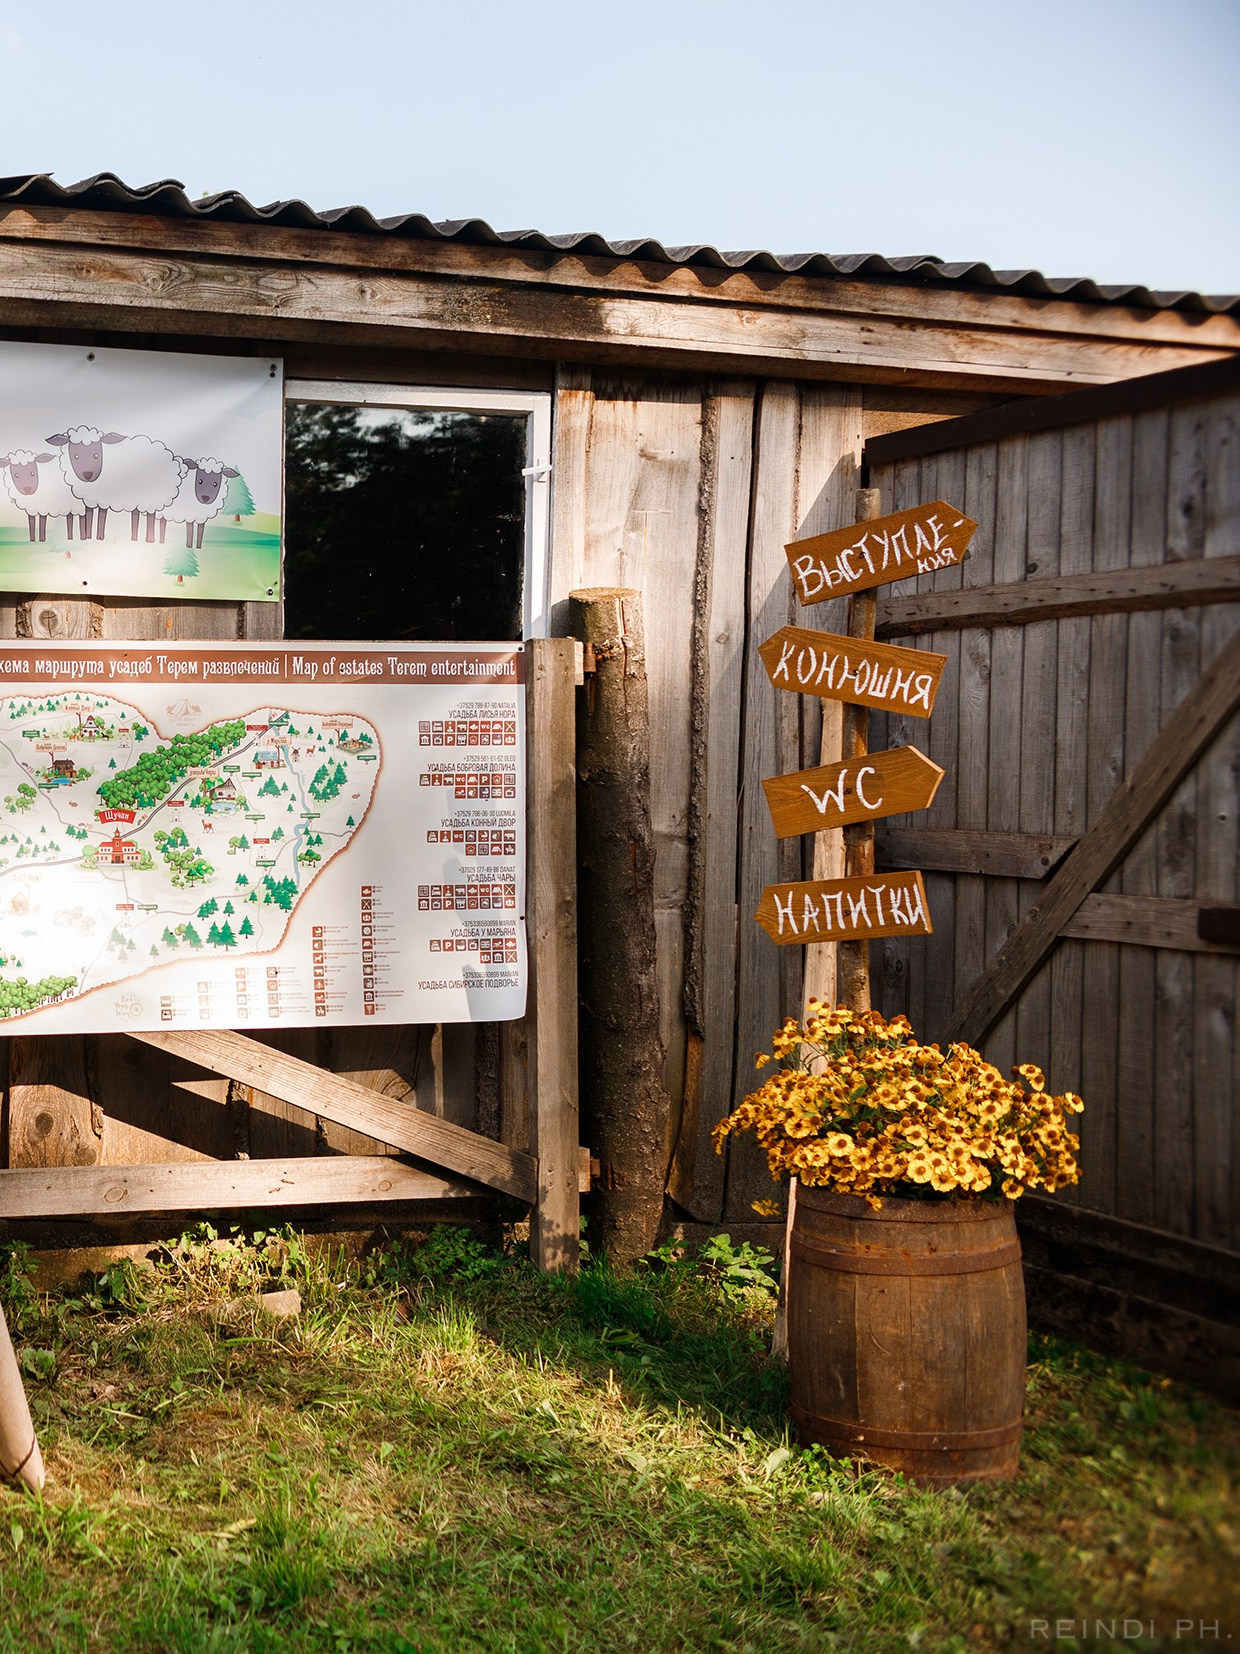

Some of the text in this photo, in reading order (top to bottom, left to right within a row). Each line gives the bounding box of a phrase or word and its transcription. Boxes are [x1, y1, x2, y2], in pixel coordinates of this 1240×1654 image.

[35, 658, 104, 679] маршрута
[109, 655, 152, 679] усадеб
[157, 655, 198, 679] Терем
[203, 657, 279, 678] развлечений
[292, 656, 515, 679] Map of estates Terem entertainment
[772, 641, 933, 710] КОНЮШНЯ
[448, 710, 478, 719] УСАДЬБА
[499, 710, 516, 718] НОРА
[427, 763, 516, 772] УСАДЬБА БОБРОВАЯ ДОЛИНА
[800, 766, 882, 815] WC
[441, 818, 516, 828] УСАДЬБА КОННЫЙ ДВОР
[466, 874, 516, 882] УСАДЬБА ЧАРЫ
[773, 882, 929, 935] НАПИТКИ
[450, 928, 516, 938] УСАДЬБА У МАРЬЯНА
[418, 978, 519, 990] УСАДЬБА СИБИРСКОЕ ПОДВОРЬЕ
